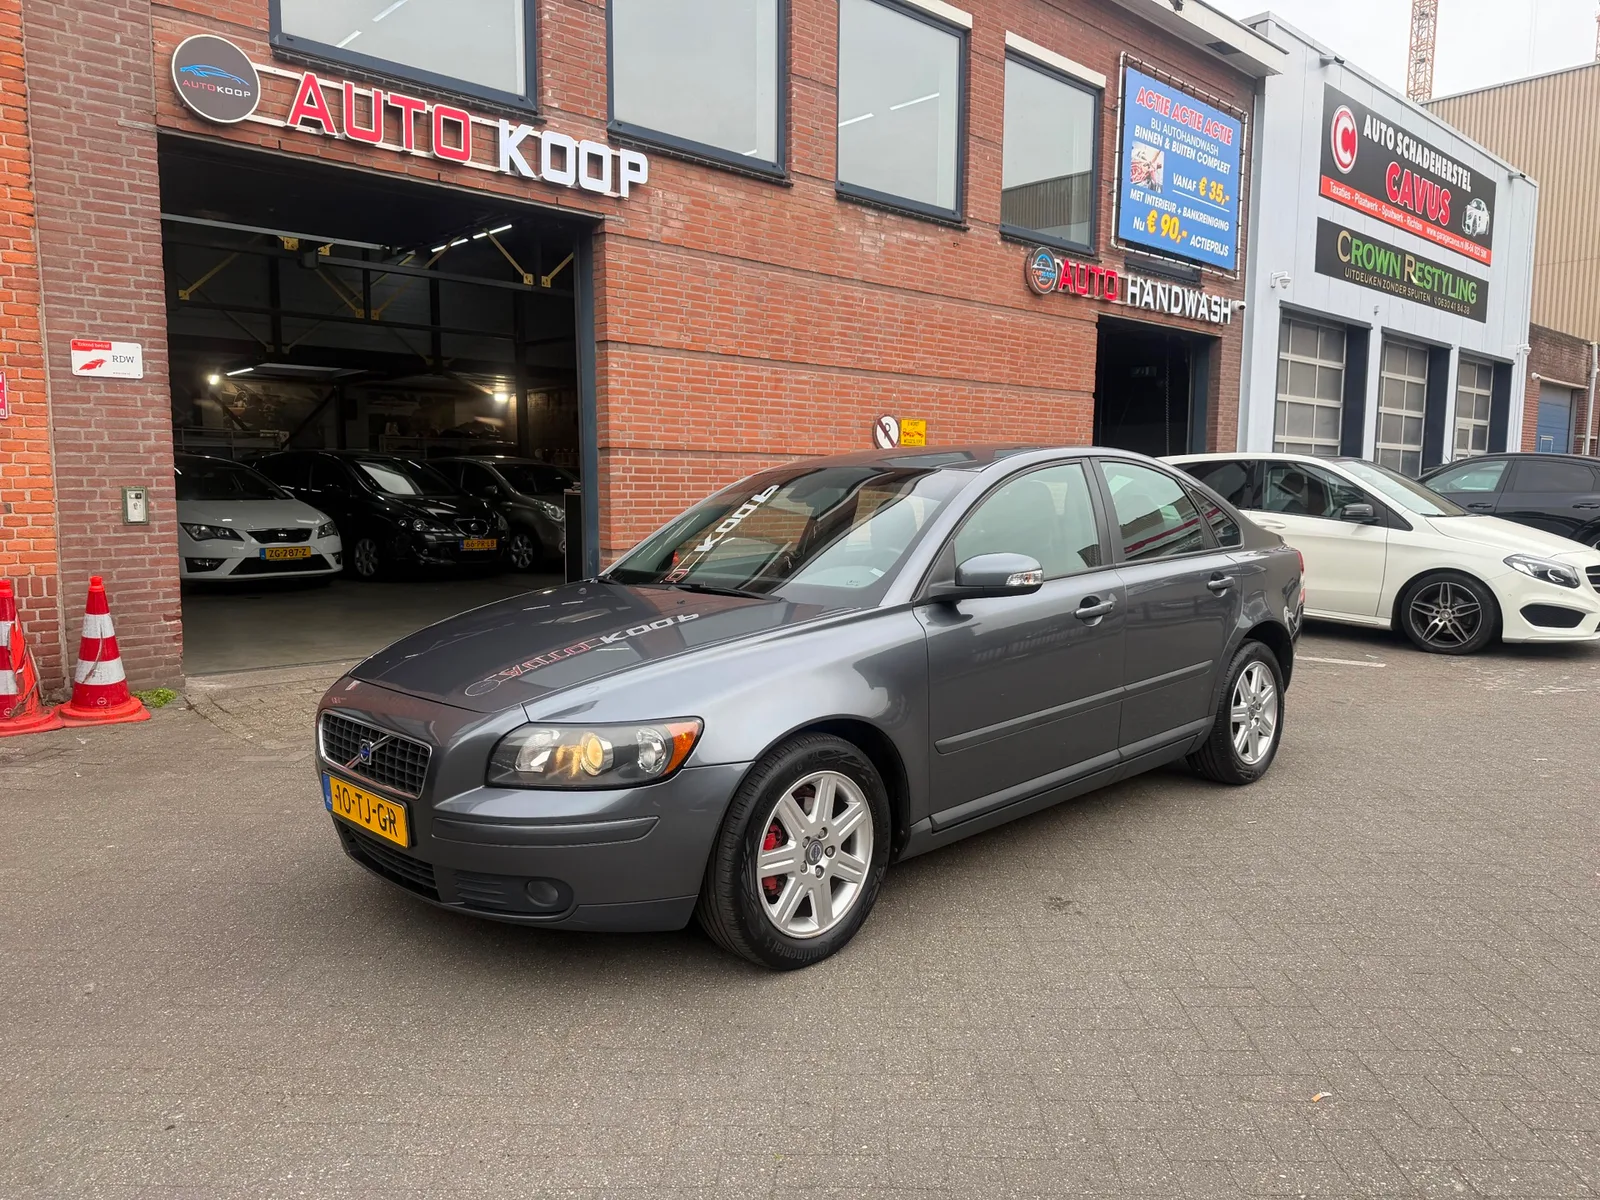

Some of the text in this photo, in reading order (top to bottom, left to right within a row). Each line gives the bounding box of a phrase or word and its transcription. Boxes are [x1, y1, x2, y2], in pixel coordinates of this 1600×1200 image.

[286, 71, 649, 199] AUTO KOOP
[1136, 86, 1233, 145] ACTIE ACTIE ACTIE
[1150, 117, 1219, 156] BIJ AUTOHANDWASH
[1134, 125, 1231, 175] BINNEN & BUITEN COMPLEET
[1363, 114, 1472, 193] AUTO SCHADEHERSTEL
[1173, 173, 1197, 192] VANAF
[1385, 161, 1452, 226] CAVUS
[1129, 188, 1144, 202] MET
[1144, 192, 1177, 214] INTERIEUR
[1182, 206, 1230, 232] BANKREINIGING
[1133, 216, 1145, 232] Nu
[1190, 234, 1230, 257] ACTIEPRIJS
[1058, 258, 1232, 325] AUTO HANDWASH
[1337, 230, 1477, 304] CROWN RESTYLING
[1344, 267, 1382, 289] UITDEUKEN
[1382, 278, 1408, 296] ZONDER
[1408, 287, 1431, 303] SPUITEN
[112, 355, 135, 364] RDW
[268, 547, 308, 560] ZG-287-Z
[336, 784, 399, 838] 10-TJ-GR
